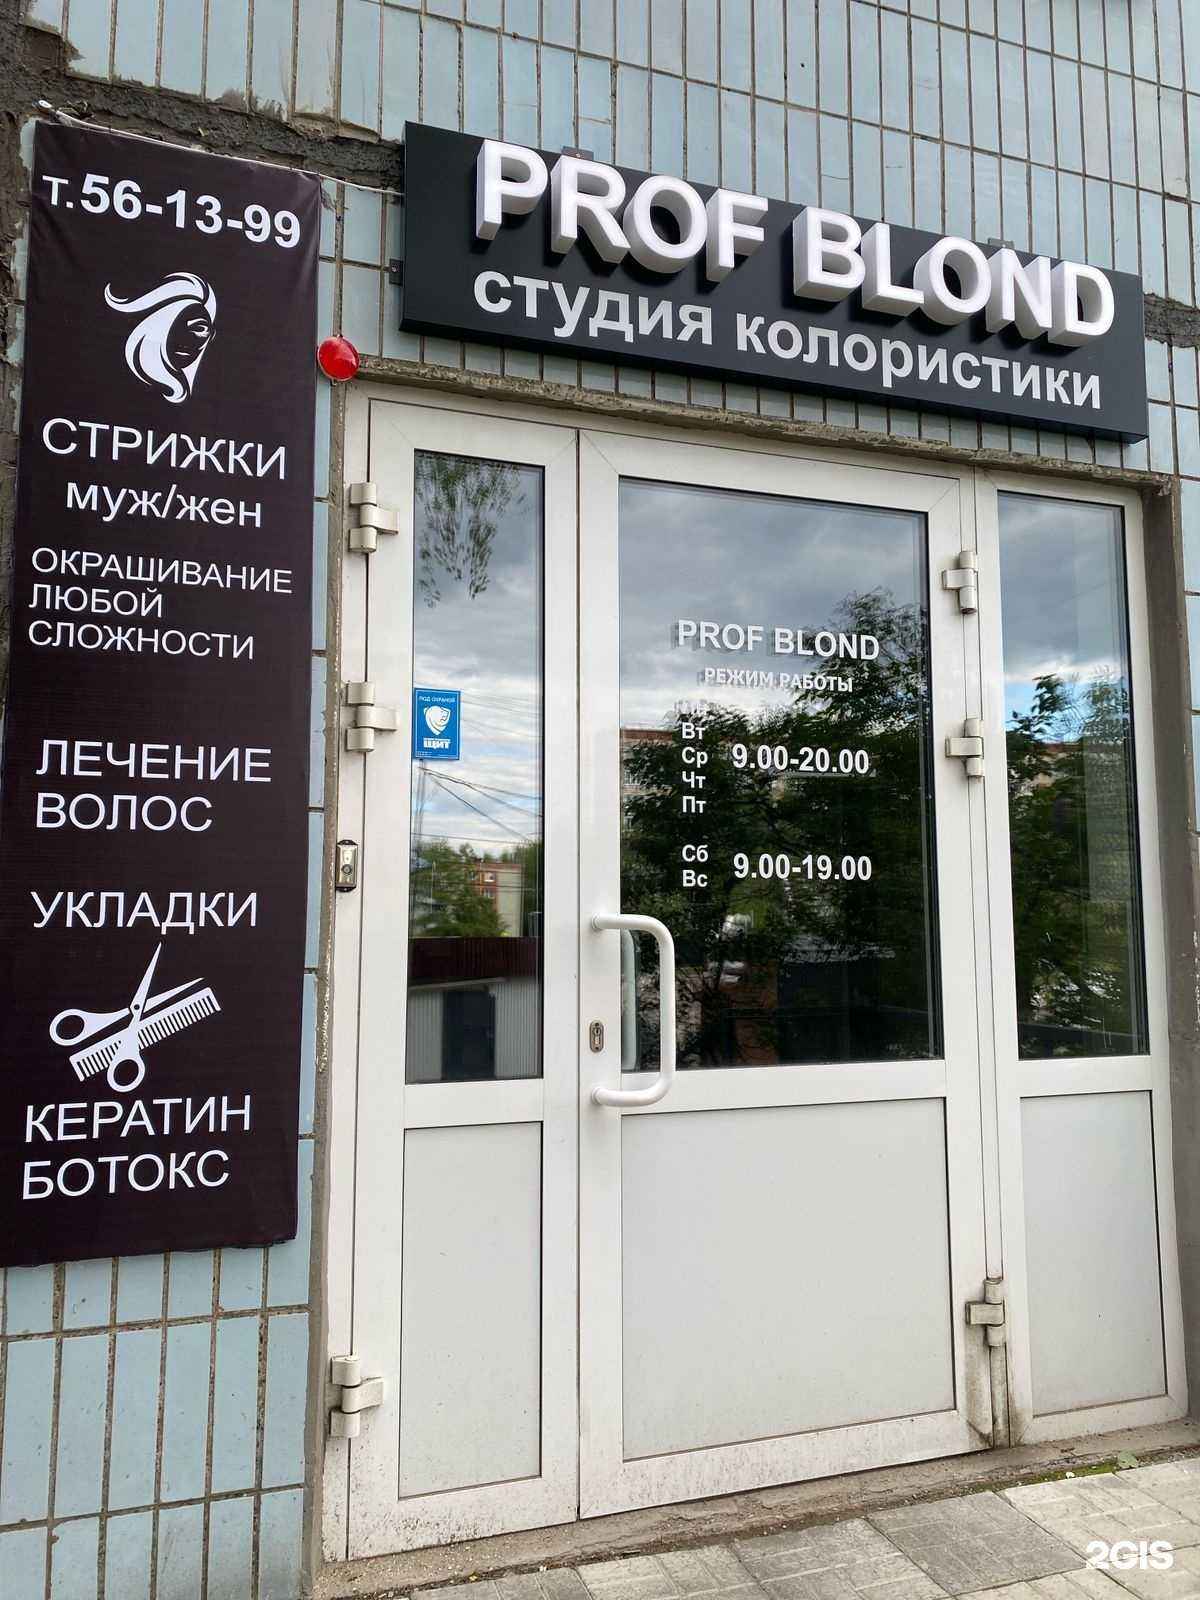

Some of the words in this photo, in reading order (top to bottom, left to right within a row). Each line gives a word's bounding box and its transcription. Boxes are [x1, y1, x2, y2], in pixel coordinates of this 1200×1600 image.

[475, 138, 769, 282] PROF
[793, 204, 1115, 347] BLOND
[473, 270, 713, 345] студия
[735, 312, 1102, 410] колористики
[41, 417, 287, 480] СТРИЖКИ
[66, 482, 262, 528] муж/жен
[31, 547, 292, 594] ОКРАШИВАНИЕ
[28, 583, 163, 618] ЛЮБОЙ
[27, 620, 254, 660] СЛОЖНОСТИ
[677, 619, 764, 651] PROF
[774, 627, 880, 661] BLOND
[704, 667, 774, 688] РЕЖИМ
[779, 672, 853, 692] РАБОТЫ
[682, 722, 706, 740] Вт
[35, 739, 273, 783] ЛЕЧЕНИЕ
[681, 746, 709, 768] Ср
[732, 743, 870, 774] 9.00-20.00
[681, 770, 707, 789] Чт
[35, 792, 213, 832] ВОЛОС
[682, 795, 707, 814] Пт
[681, 844, 709, 863] Сб
[733, 852, 872, 881] 9.00-19.00
[682, 869, 708, 888] Вс
[30, 891, 258, 935] УКЛАДКИ
[25, 1094, 252, 1143] КЕРАТИН
[22, 1149, 230, 1200] БОТОКС
